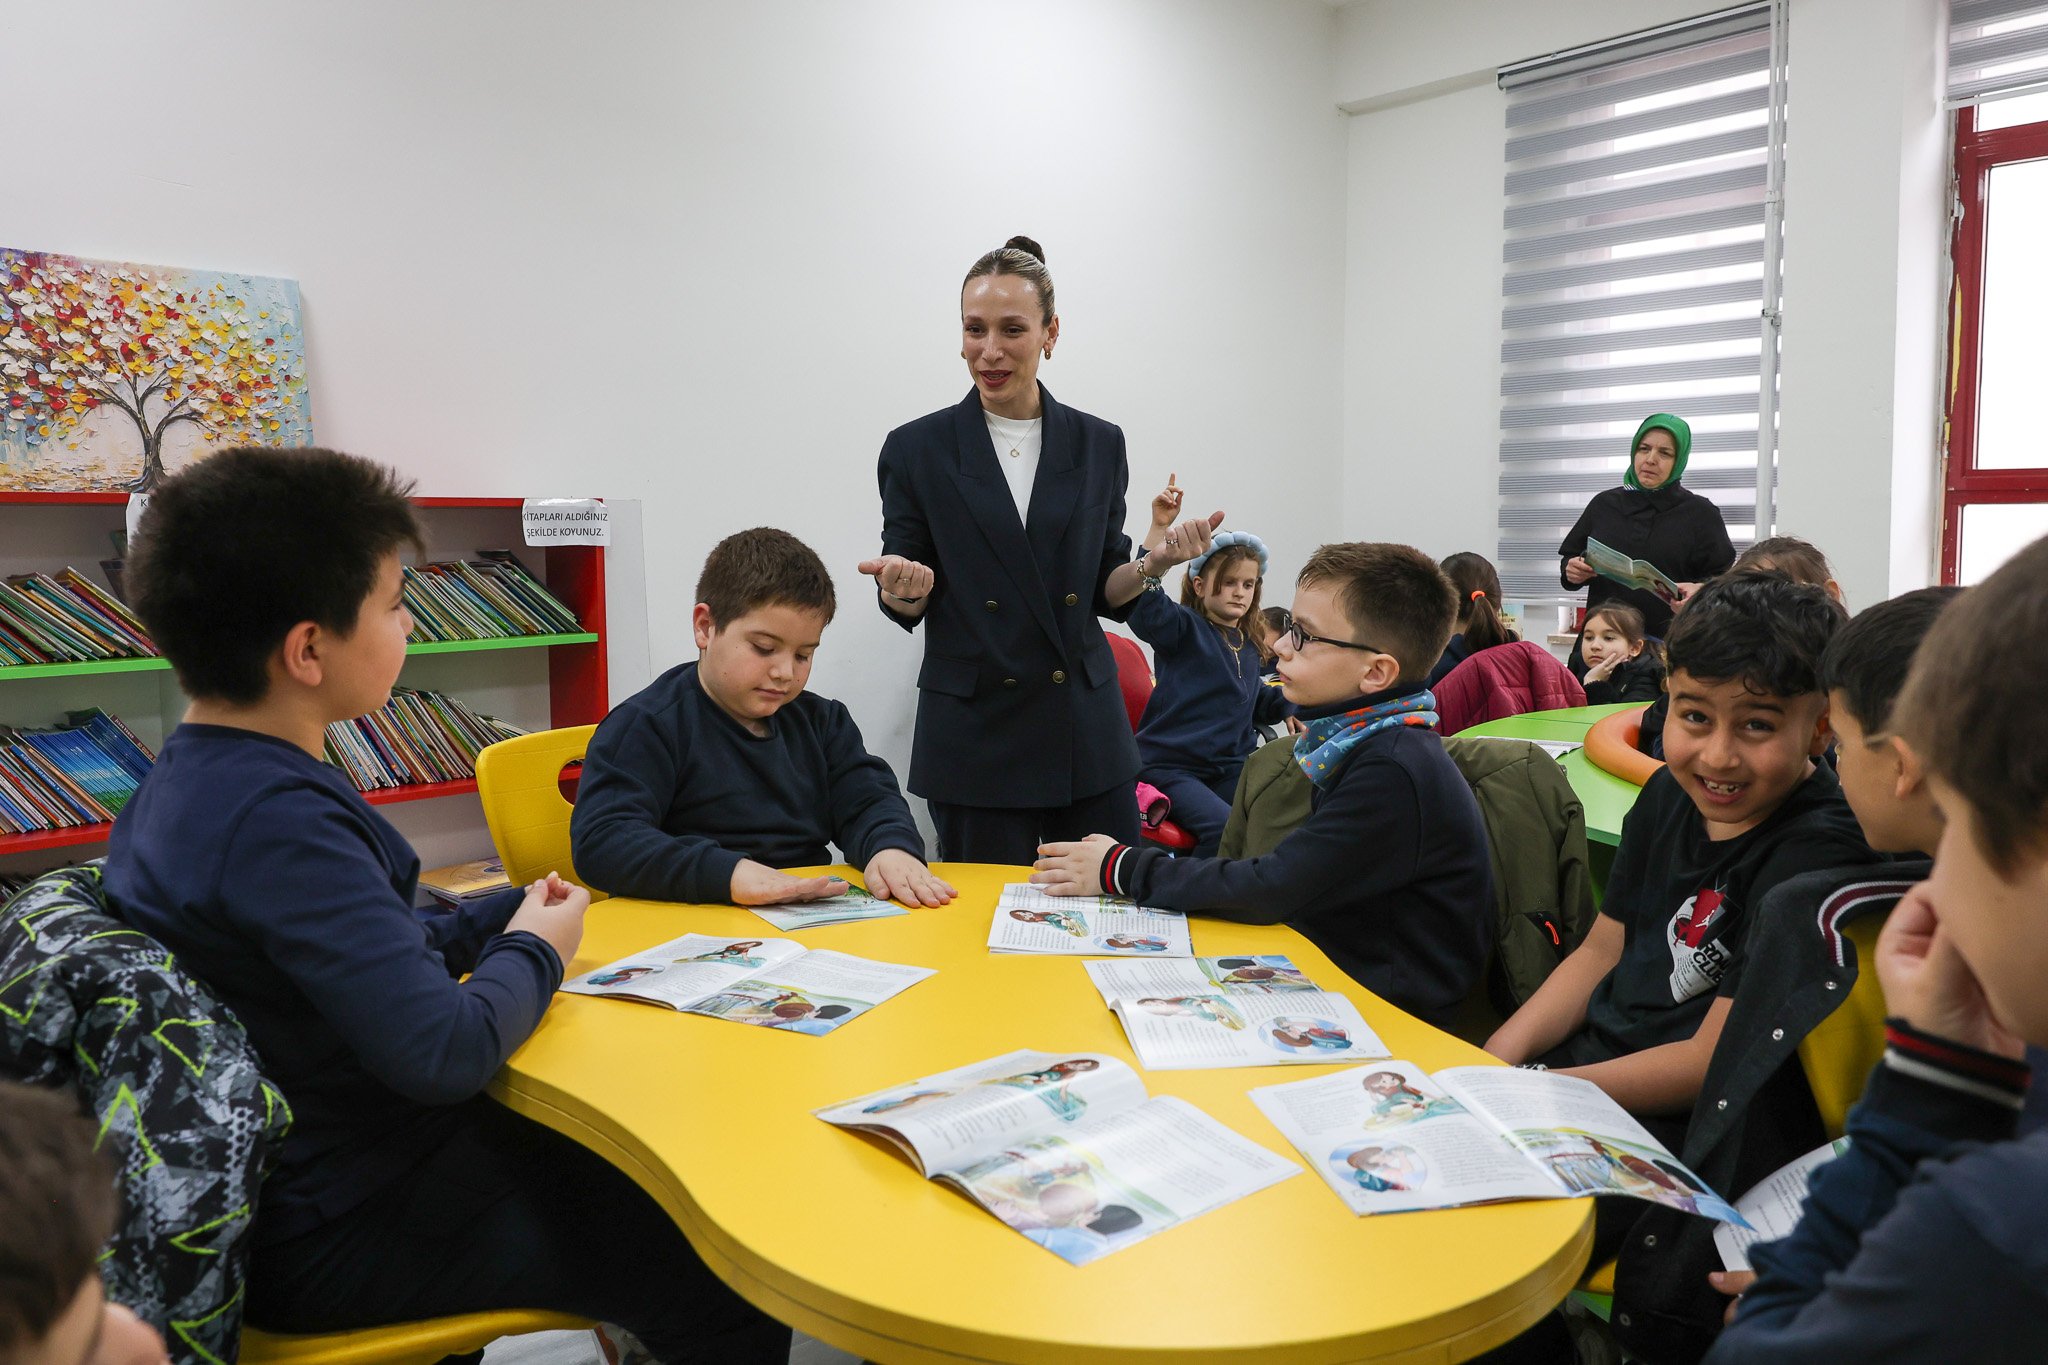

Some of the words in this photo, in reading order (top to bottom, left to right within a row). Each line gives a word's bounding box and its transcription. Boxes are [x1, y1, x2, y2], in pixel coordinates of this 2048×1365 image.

[565, 510, 608, 522] ALDIĞINIZ
[526, 526, 558, 539] ŞEKİLDE
[560, 527, 604, 537] KOYUNUZ.
